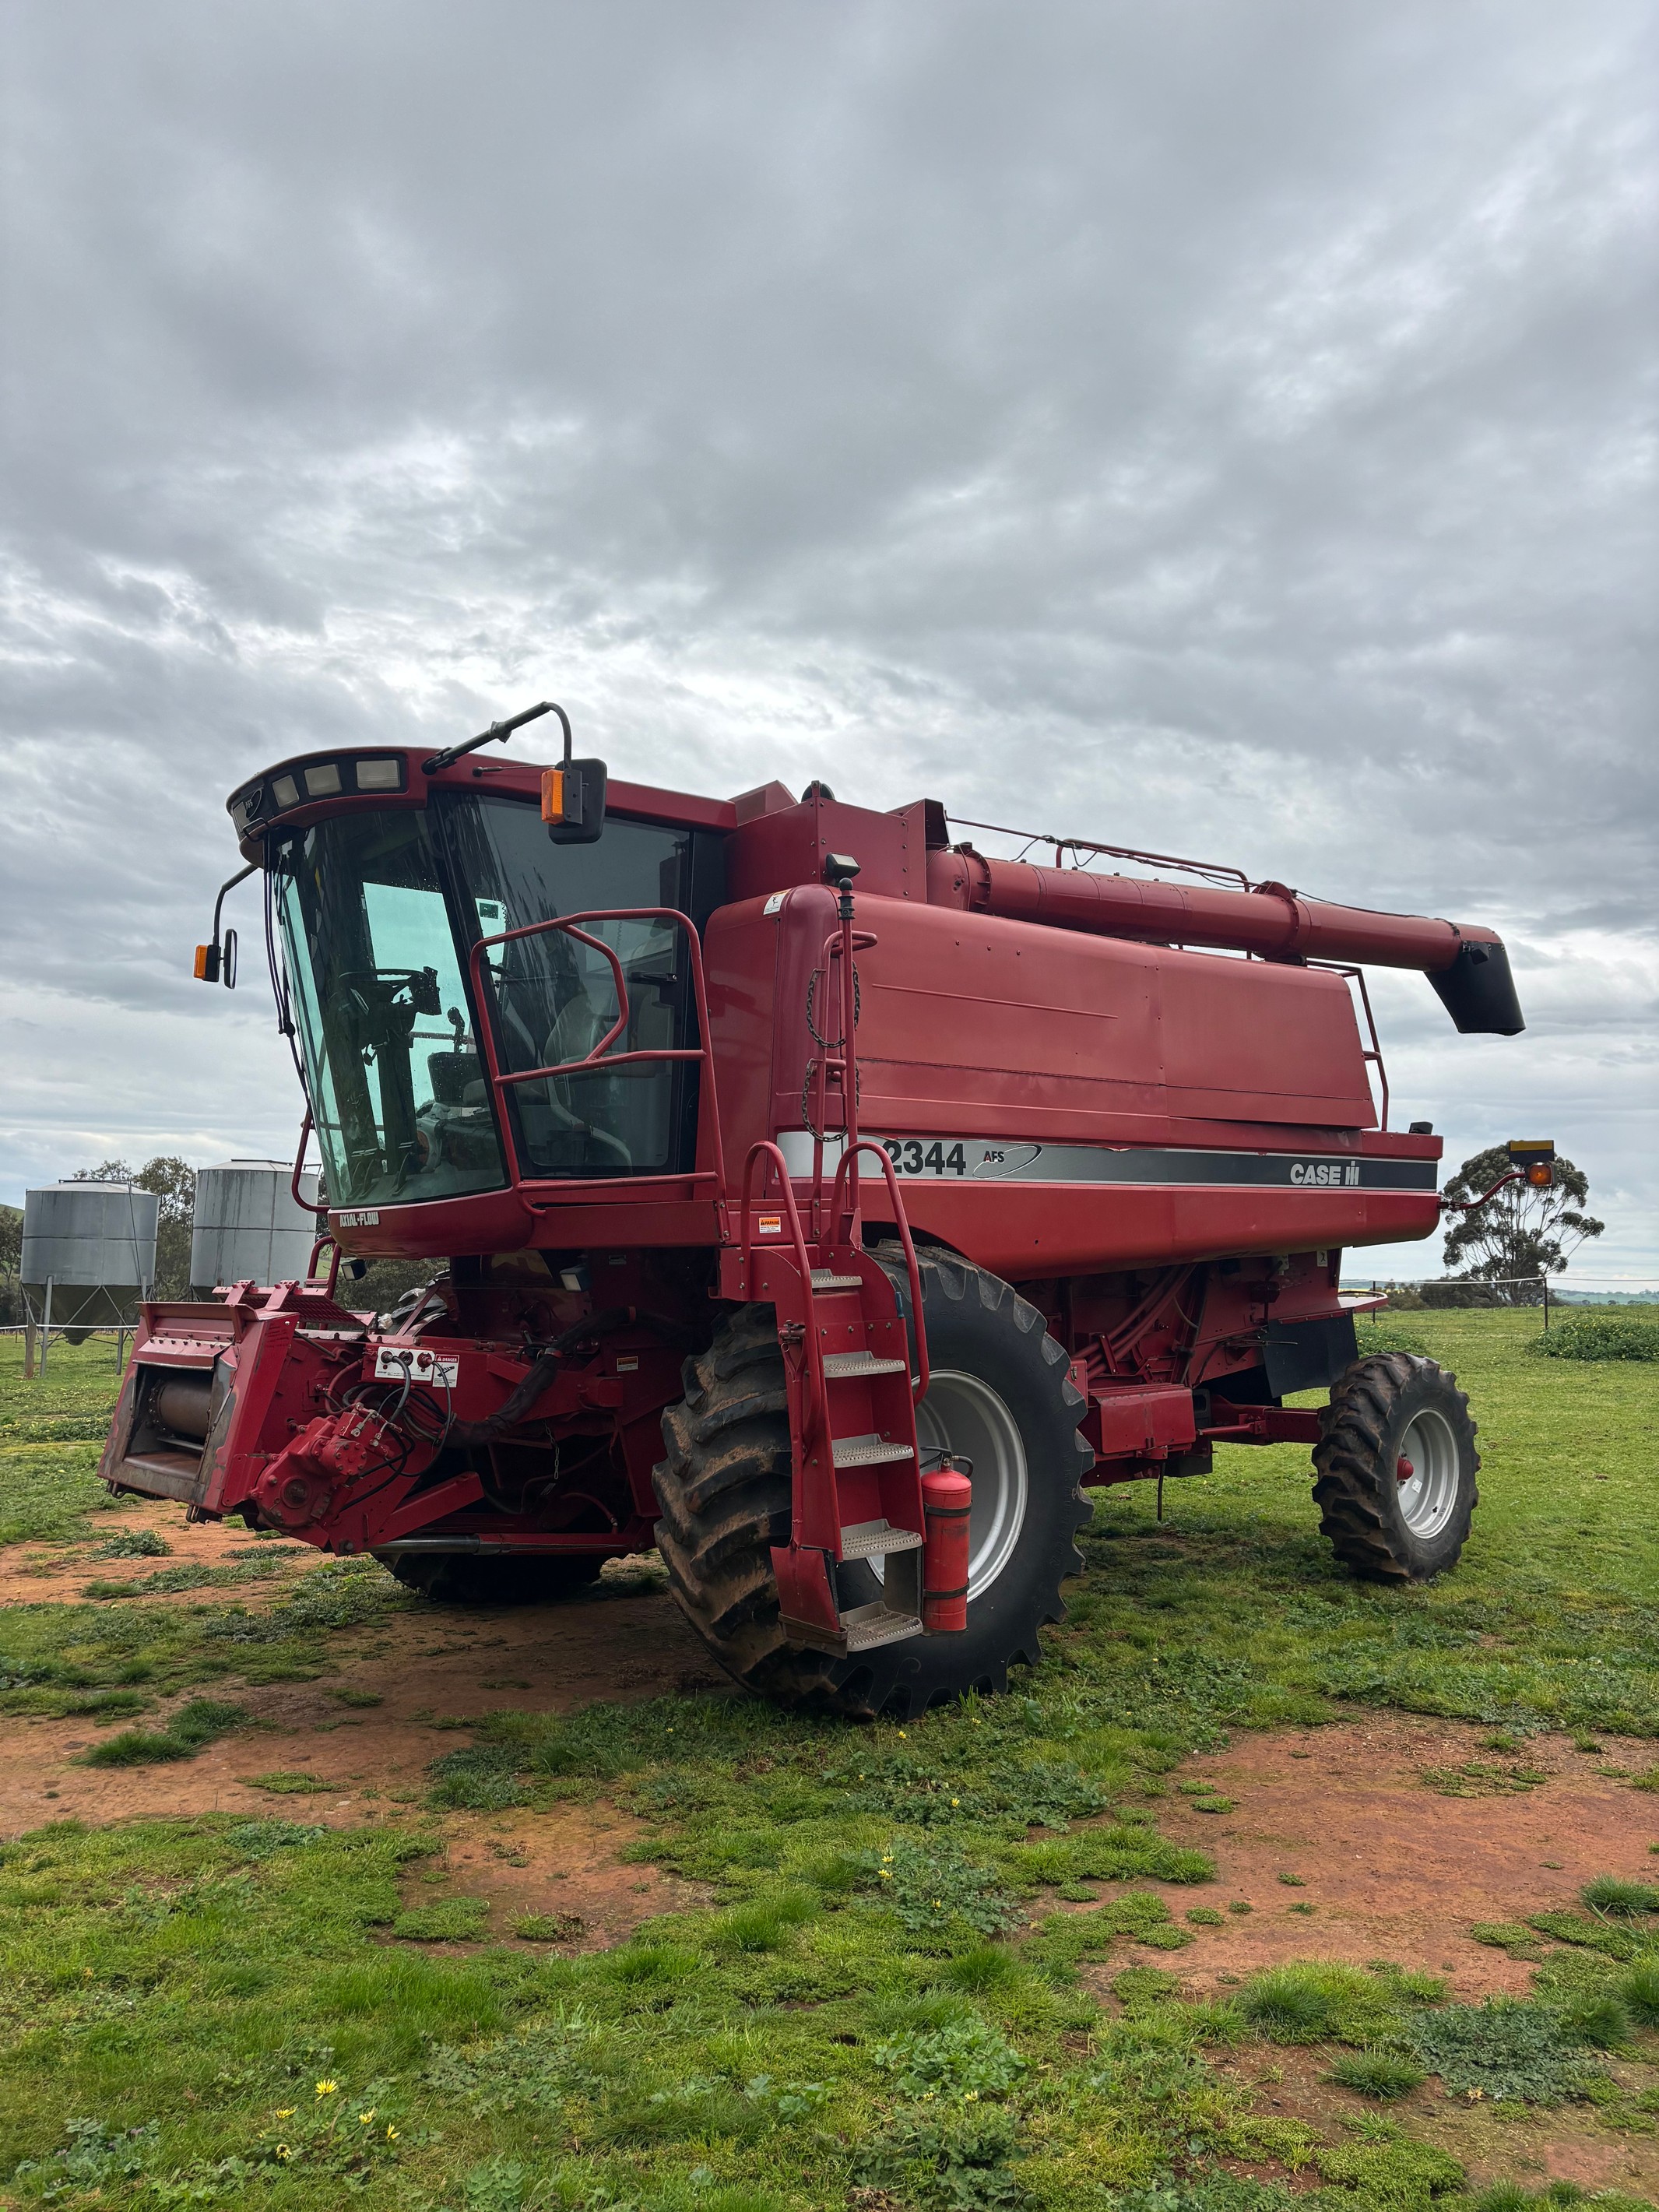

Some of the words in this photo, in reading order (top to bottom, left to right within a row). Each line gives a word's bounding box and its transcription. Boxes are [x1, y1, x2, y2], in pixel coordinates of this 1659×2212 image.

[882, 1141, 967, 1176] 2344
[983, 1150, 1005, 1164] AFS
[1290, 1163, 1341, 1185] CASE
[339, 1212, 379, 1228] AXIAL-FLOW
